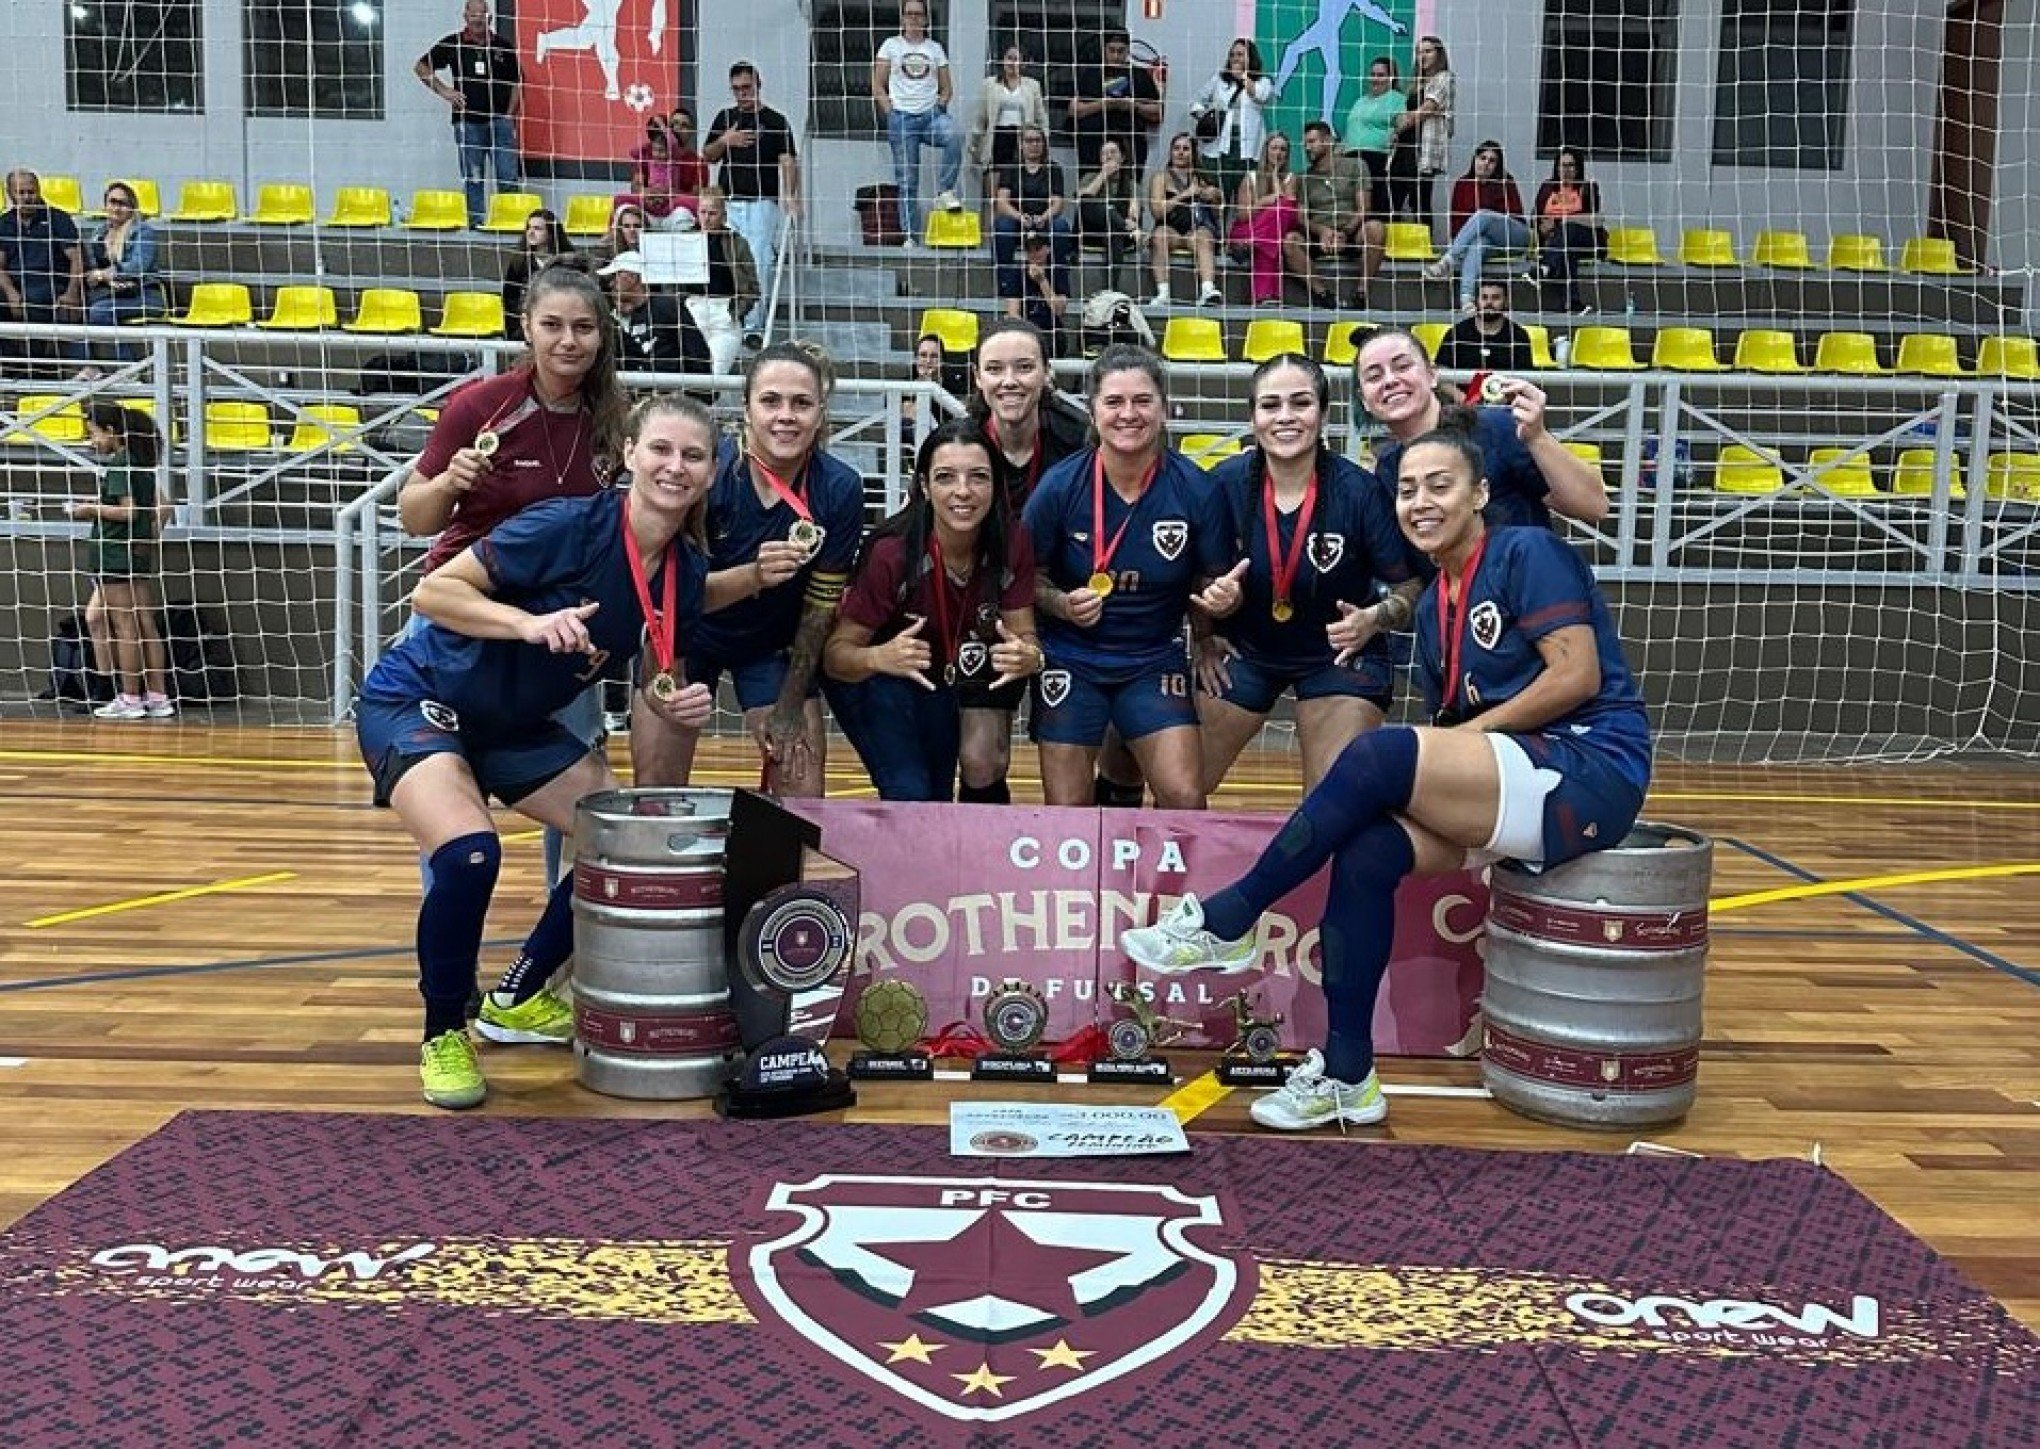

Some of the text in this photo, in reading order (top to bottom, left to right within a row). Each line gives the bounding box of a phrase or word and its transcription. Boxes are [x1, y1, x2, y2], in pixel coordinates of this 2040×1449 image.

[1161, 673, 1186, 697] 10
[1009, 836, 1187, 873] COPA
[855, 890, 1323, 987] ROTHENR
[941, 1189, 1052, 1209] PFC
